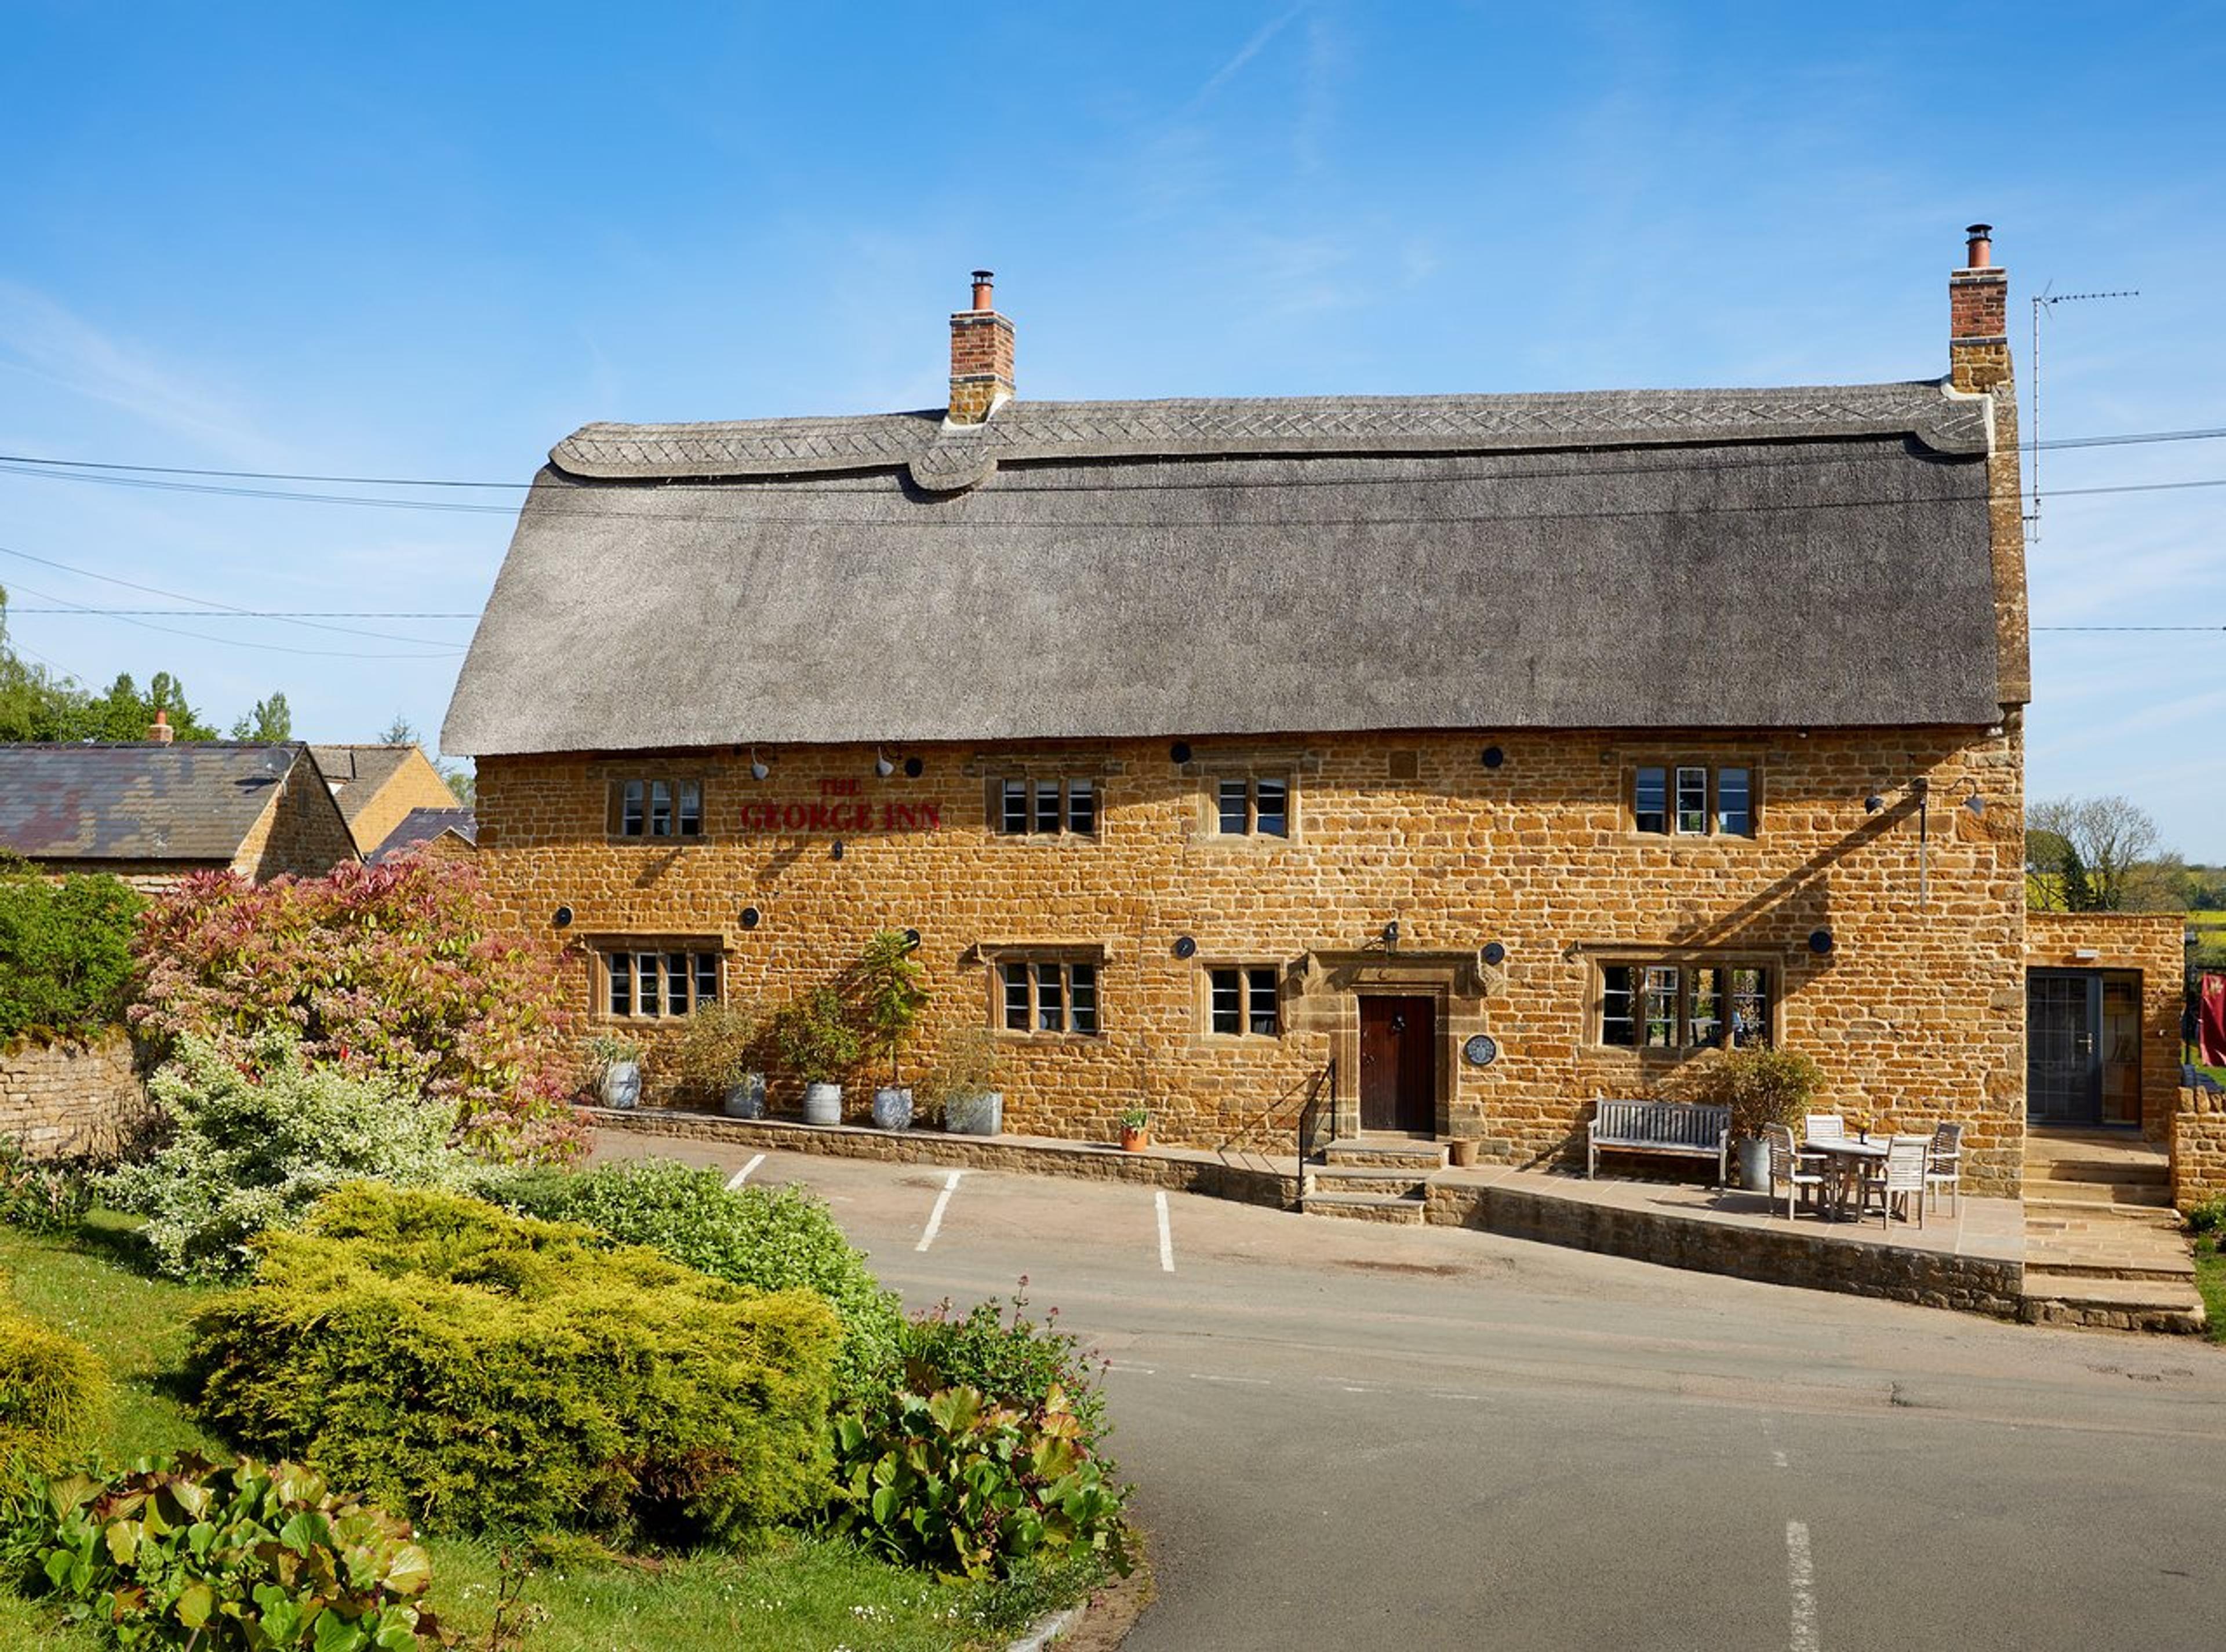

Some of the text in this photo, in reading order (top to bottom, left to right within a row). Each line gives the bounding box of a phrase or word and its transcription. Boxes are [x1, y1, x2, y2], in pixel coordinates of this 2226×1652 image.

[820, 778, 862, 796] THE
[741, 802, 942, 831] GEORGE INN
